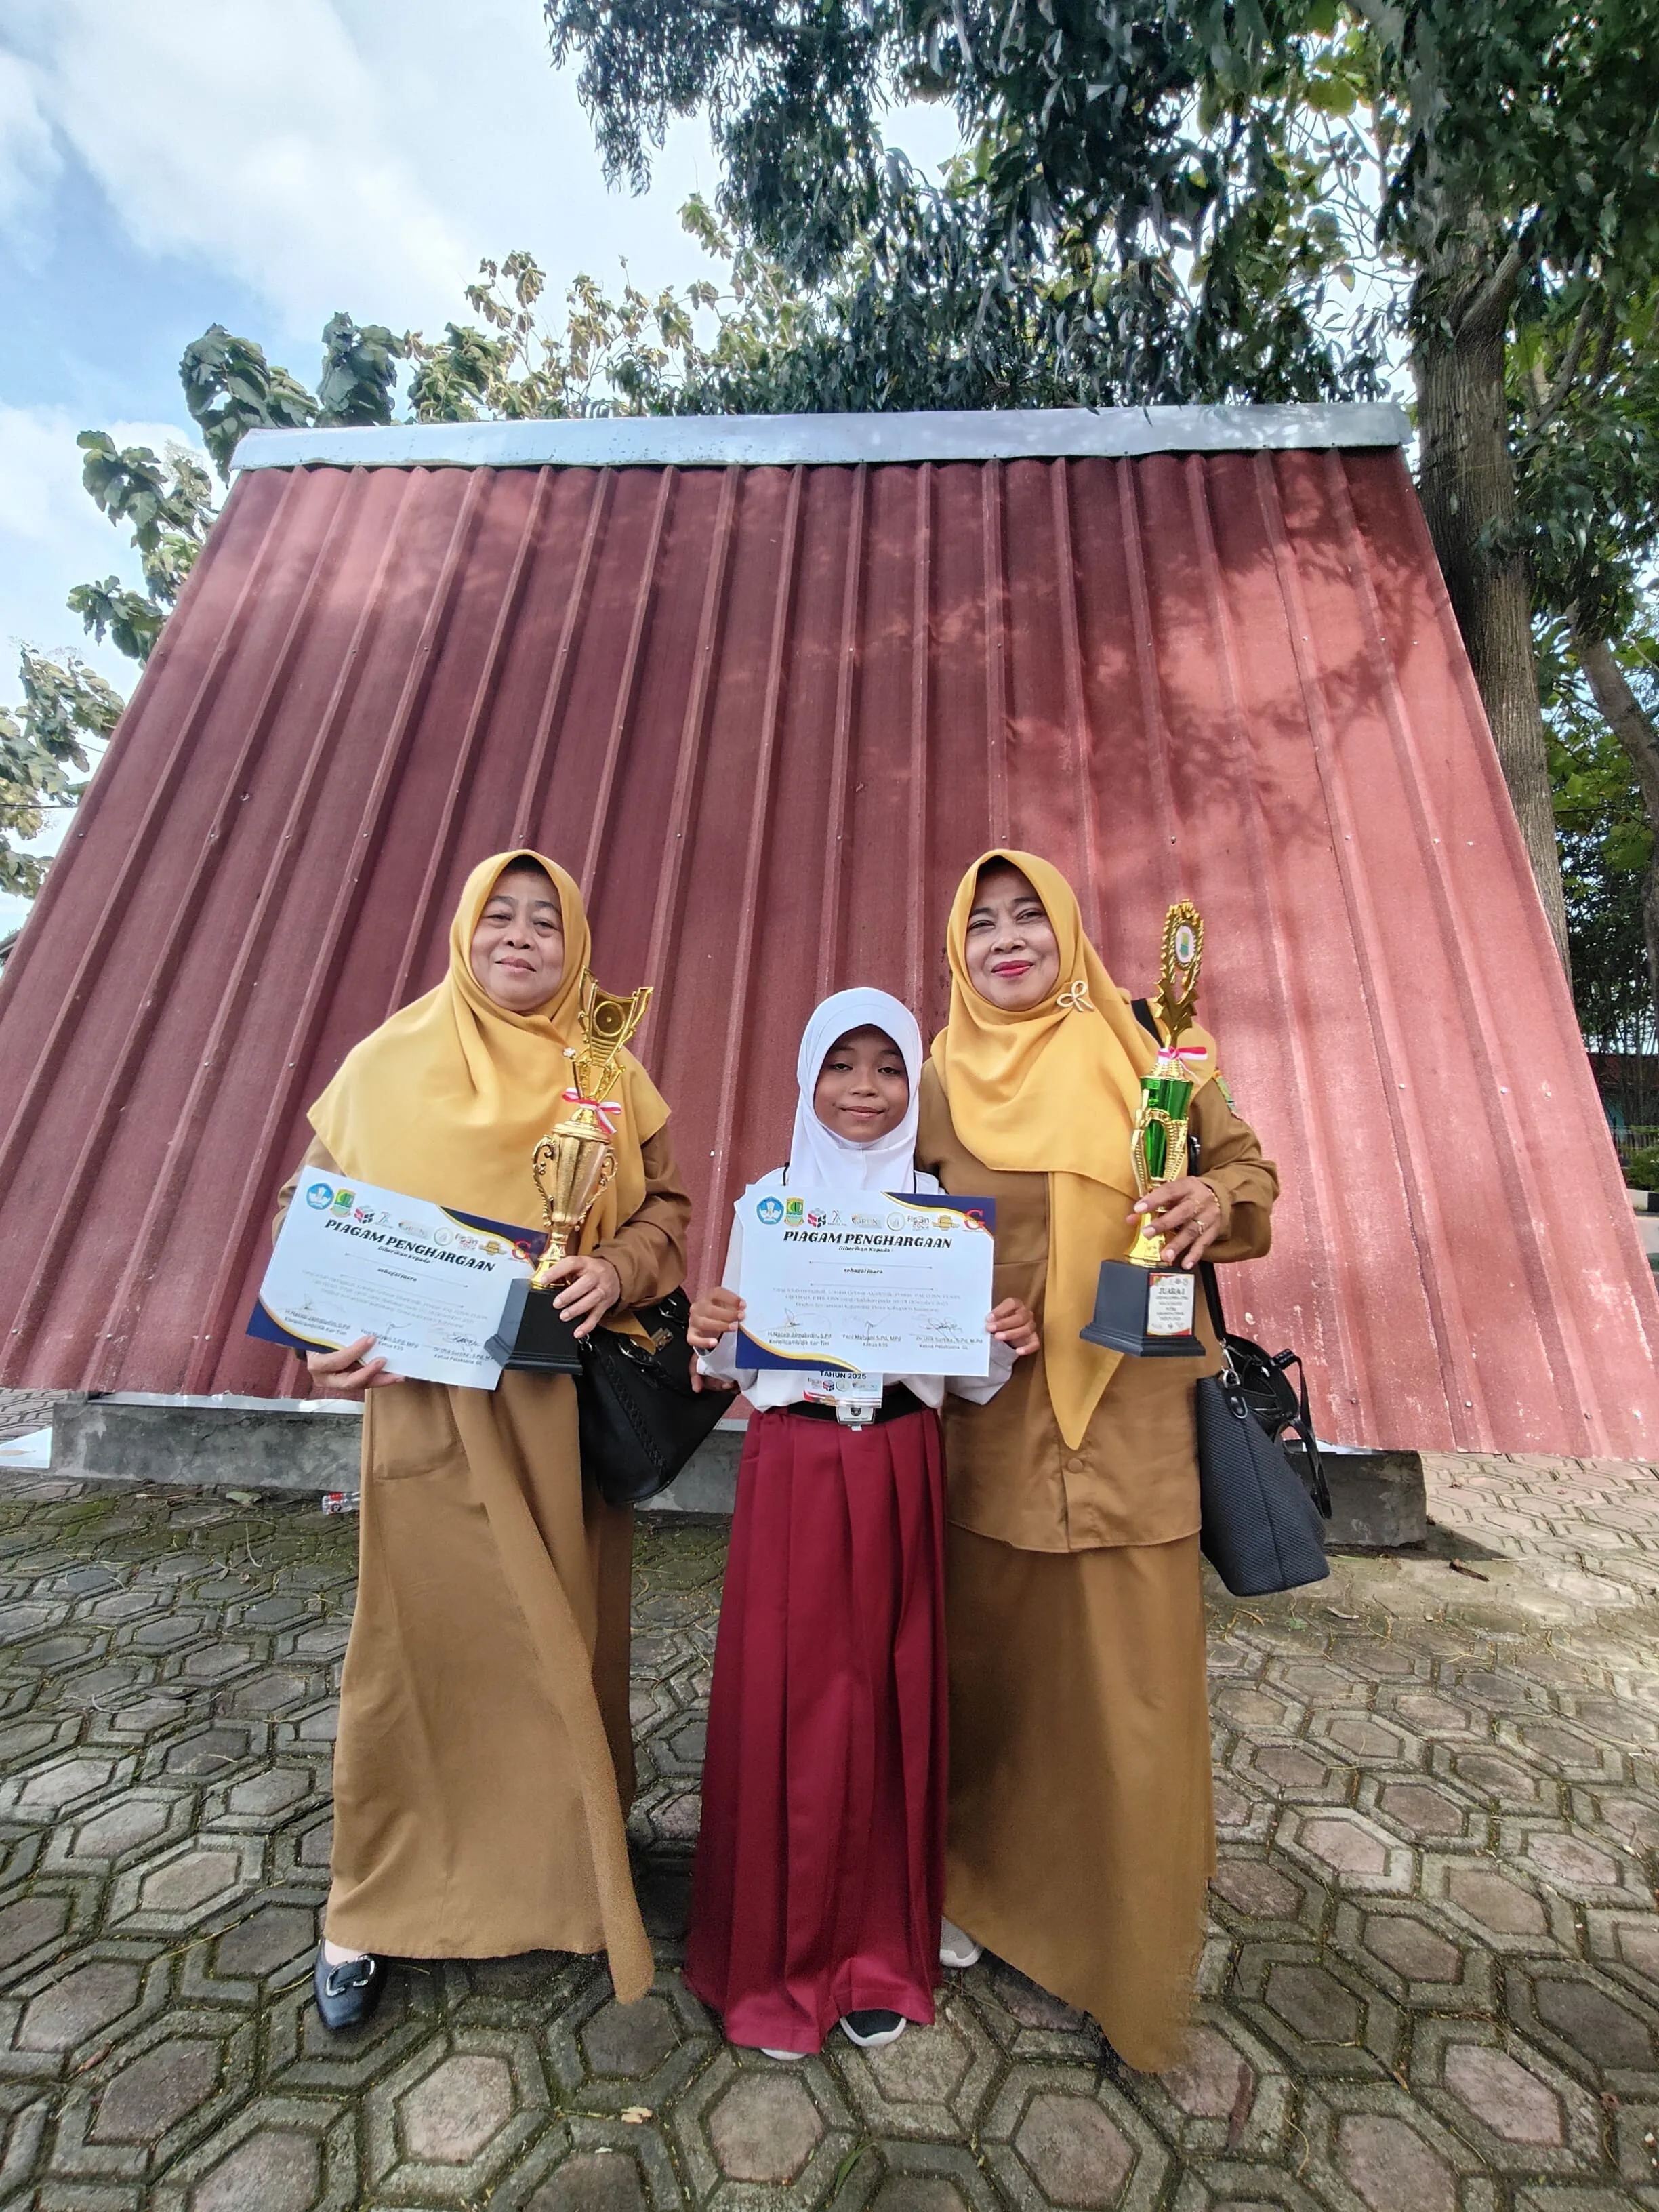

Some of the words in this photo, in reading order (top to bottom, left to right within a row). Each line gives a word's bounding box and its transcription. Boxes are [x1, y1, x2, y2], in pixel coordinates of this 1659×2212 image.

[325, 1219, 386, 1243] PIAGAM
[385, 1236, 496, 1271] PENGHARGAAN
[783, 1231, 842, 1244] PIAGAM
[844, 1233, 953, 1248] PENGHARGAAN
[820, 1370, 846, 1379] TAHUN
